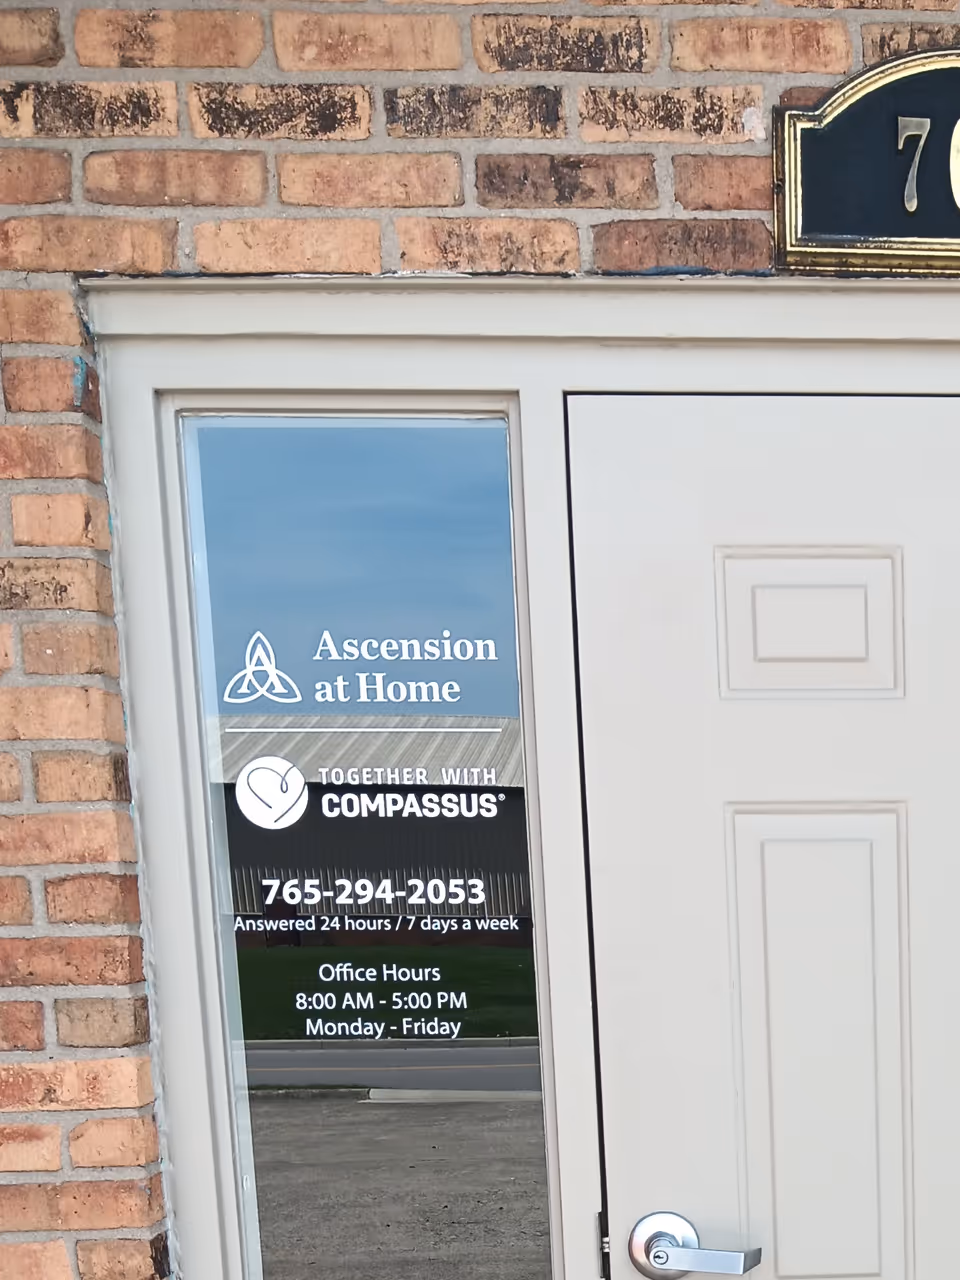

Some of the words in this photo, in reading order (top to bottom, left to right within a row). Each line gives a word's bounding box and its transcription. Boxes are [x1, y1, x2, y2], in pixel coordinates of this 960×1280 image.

[312, 630, 499, 661] Ascension
[314, 675, 350, 703] at
[355, 672, 461, 703] Home
[318, 767, 429, 785] TOGETHER
[441, 767, 497, 786] WITH
[261, 878, 486, 906] 765-294-2053
[233, 916, 316, 932] Answered
[320, 916, 341, 931] 24
[344, 916, 392, 931] hours
[395, 916, 403, 932] /
[406, 917, 416, 931] 7
[420, 916, 459, 934] days
[462, 919, 472, 931] a
[475, 916, 519, 931] week
[318, 963, 377, 982] Office
[382, 964, 441, 982] Hours
[295, 993, 336, 1010] 8:00
[342, 992, 374, 1009] AM
[391, 992, 432, 1010] 5:00
[437, 992, 467, 1009] PM
[305, 1017, 385, 1040] Monday
[402, 1018, 461, 1039] Friday
